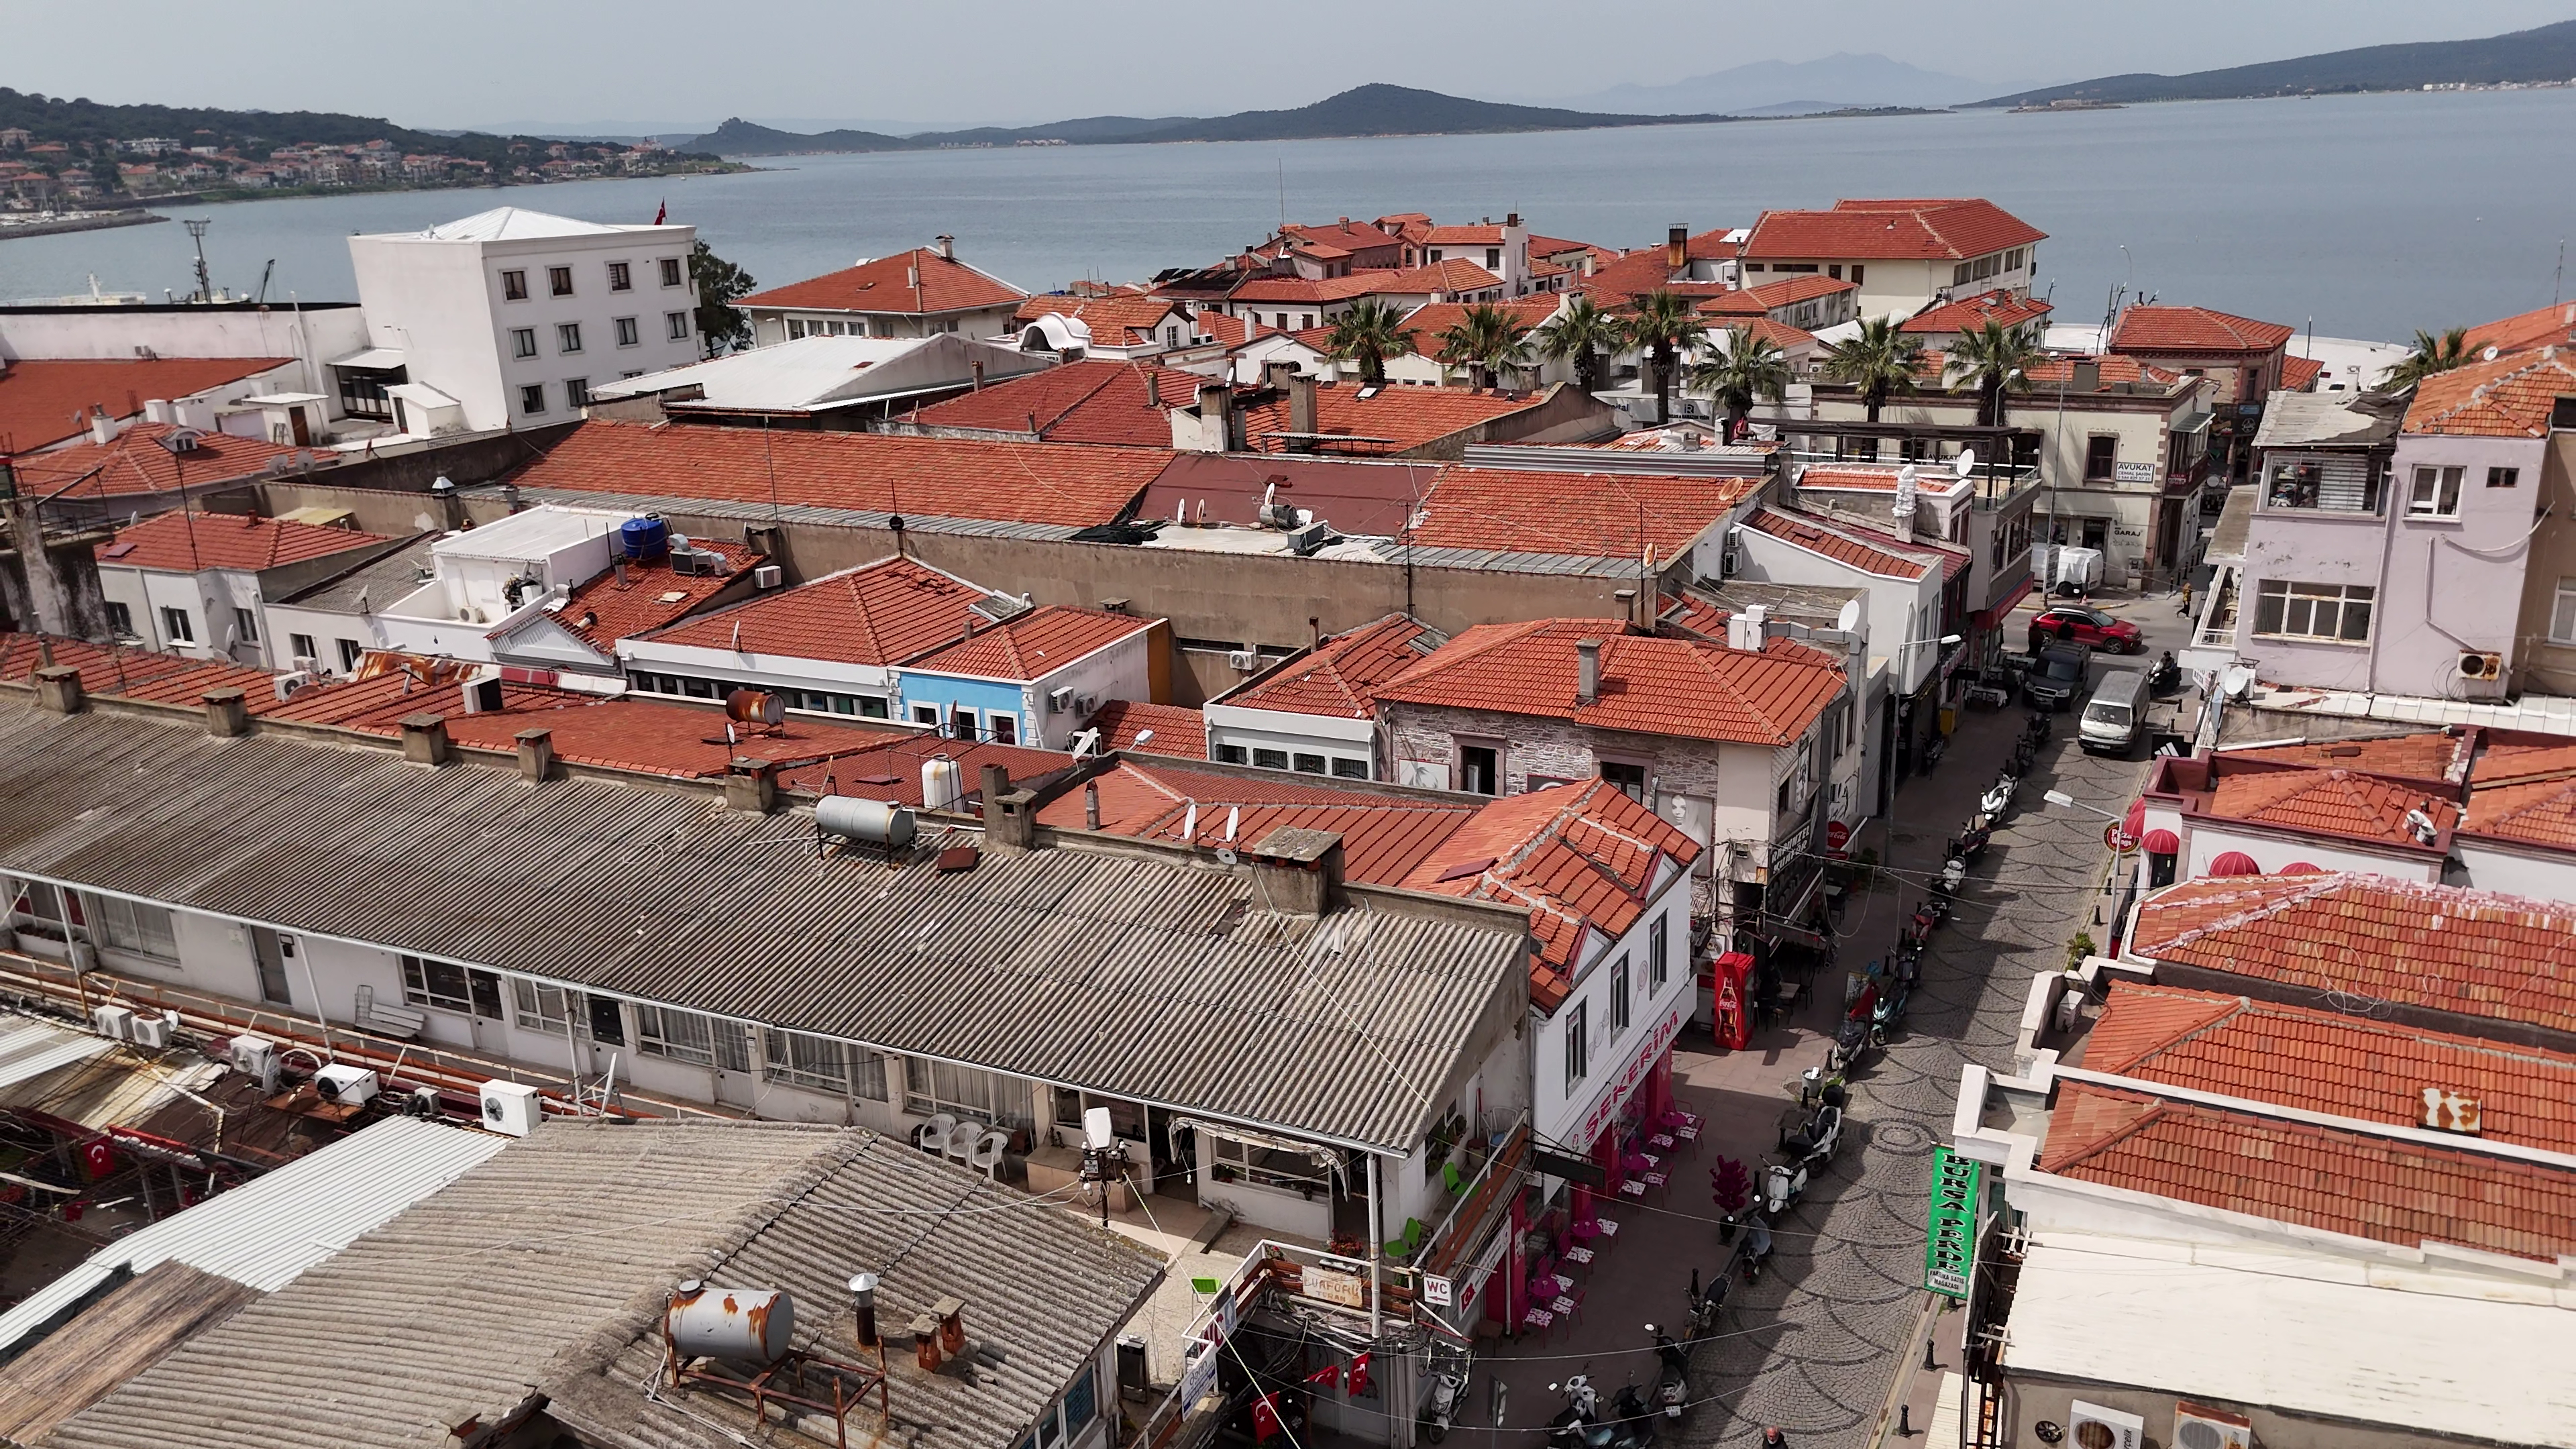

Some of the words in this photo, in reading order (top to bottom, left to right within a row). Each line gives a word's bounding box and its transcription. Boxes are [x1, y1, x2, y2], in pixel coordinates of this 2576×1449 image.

[2112, 829, 2132, 839] Pzza
[2111, 837, 2132, 847] Wngs
[1936, 1153, 1972, 1214] BURSA
[1933, 1217, 1966, 1273] PERDE
[1427, 1281, 1448, 1295] WC
